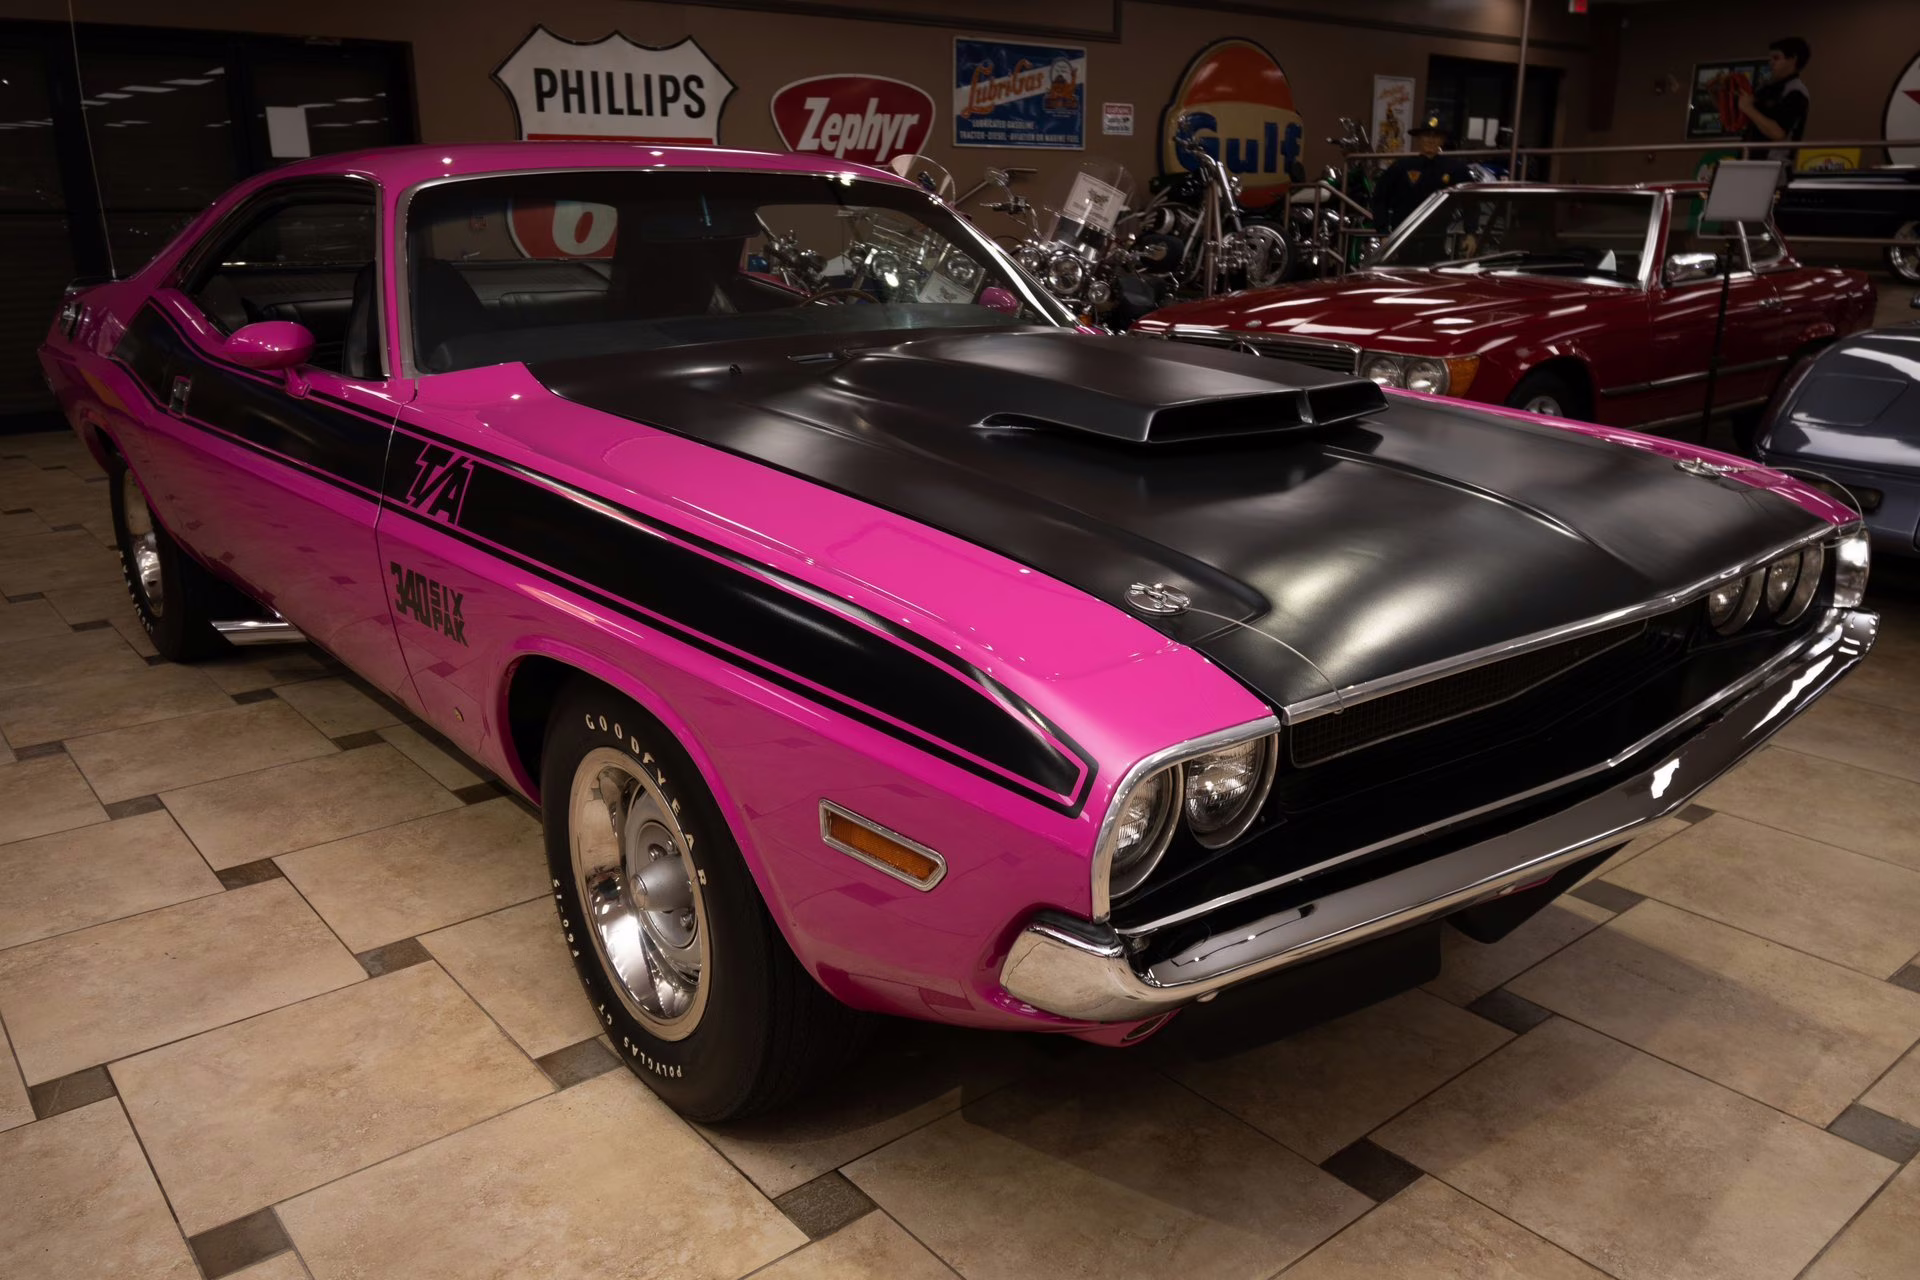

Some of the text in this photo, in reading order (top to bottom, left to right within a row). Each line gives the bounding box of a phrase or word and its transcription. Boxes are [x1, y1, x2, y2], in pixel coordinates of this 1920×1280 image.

[533, 67, 706, 119] PHILLIPS
[796, 97, 920, 162] Zephyr
[1176, 112, 1302, 174] Gulf
[391, 561, 464, 628] 340 SIX
[432, 606, 469, 649] PAK
[586, 714, 707, 886] GOODYEAR
[624, 1037, 682, 1077] POLYGLAS
